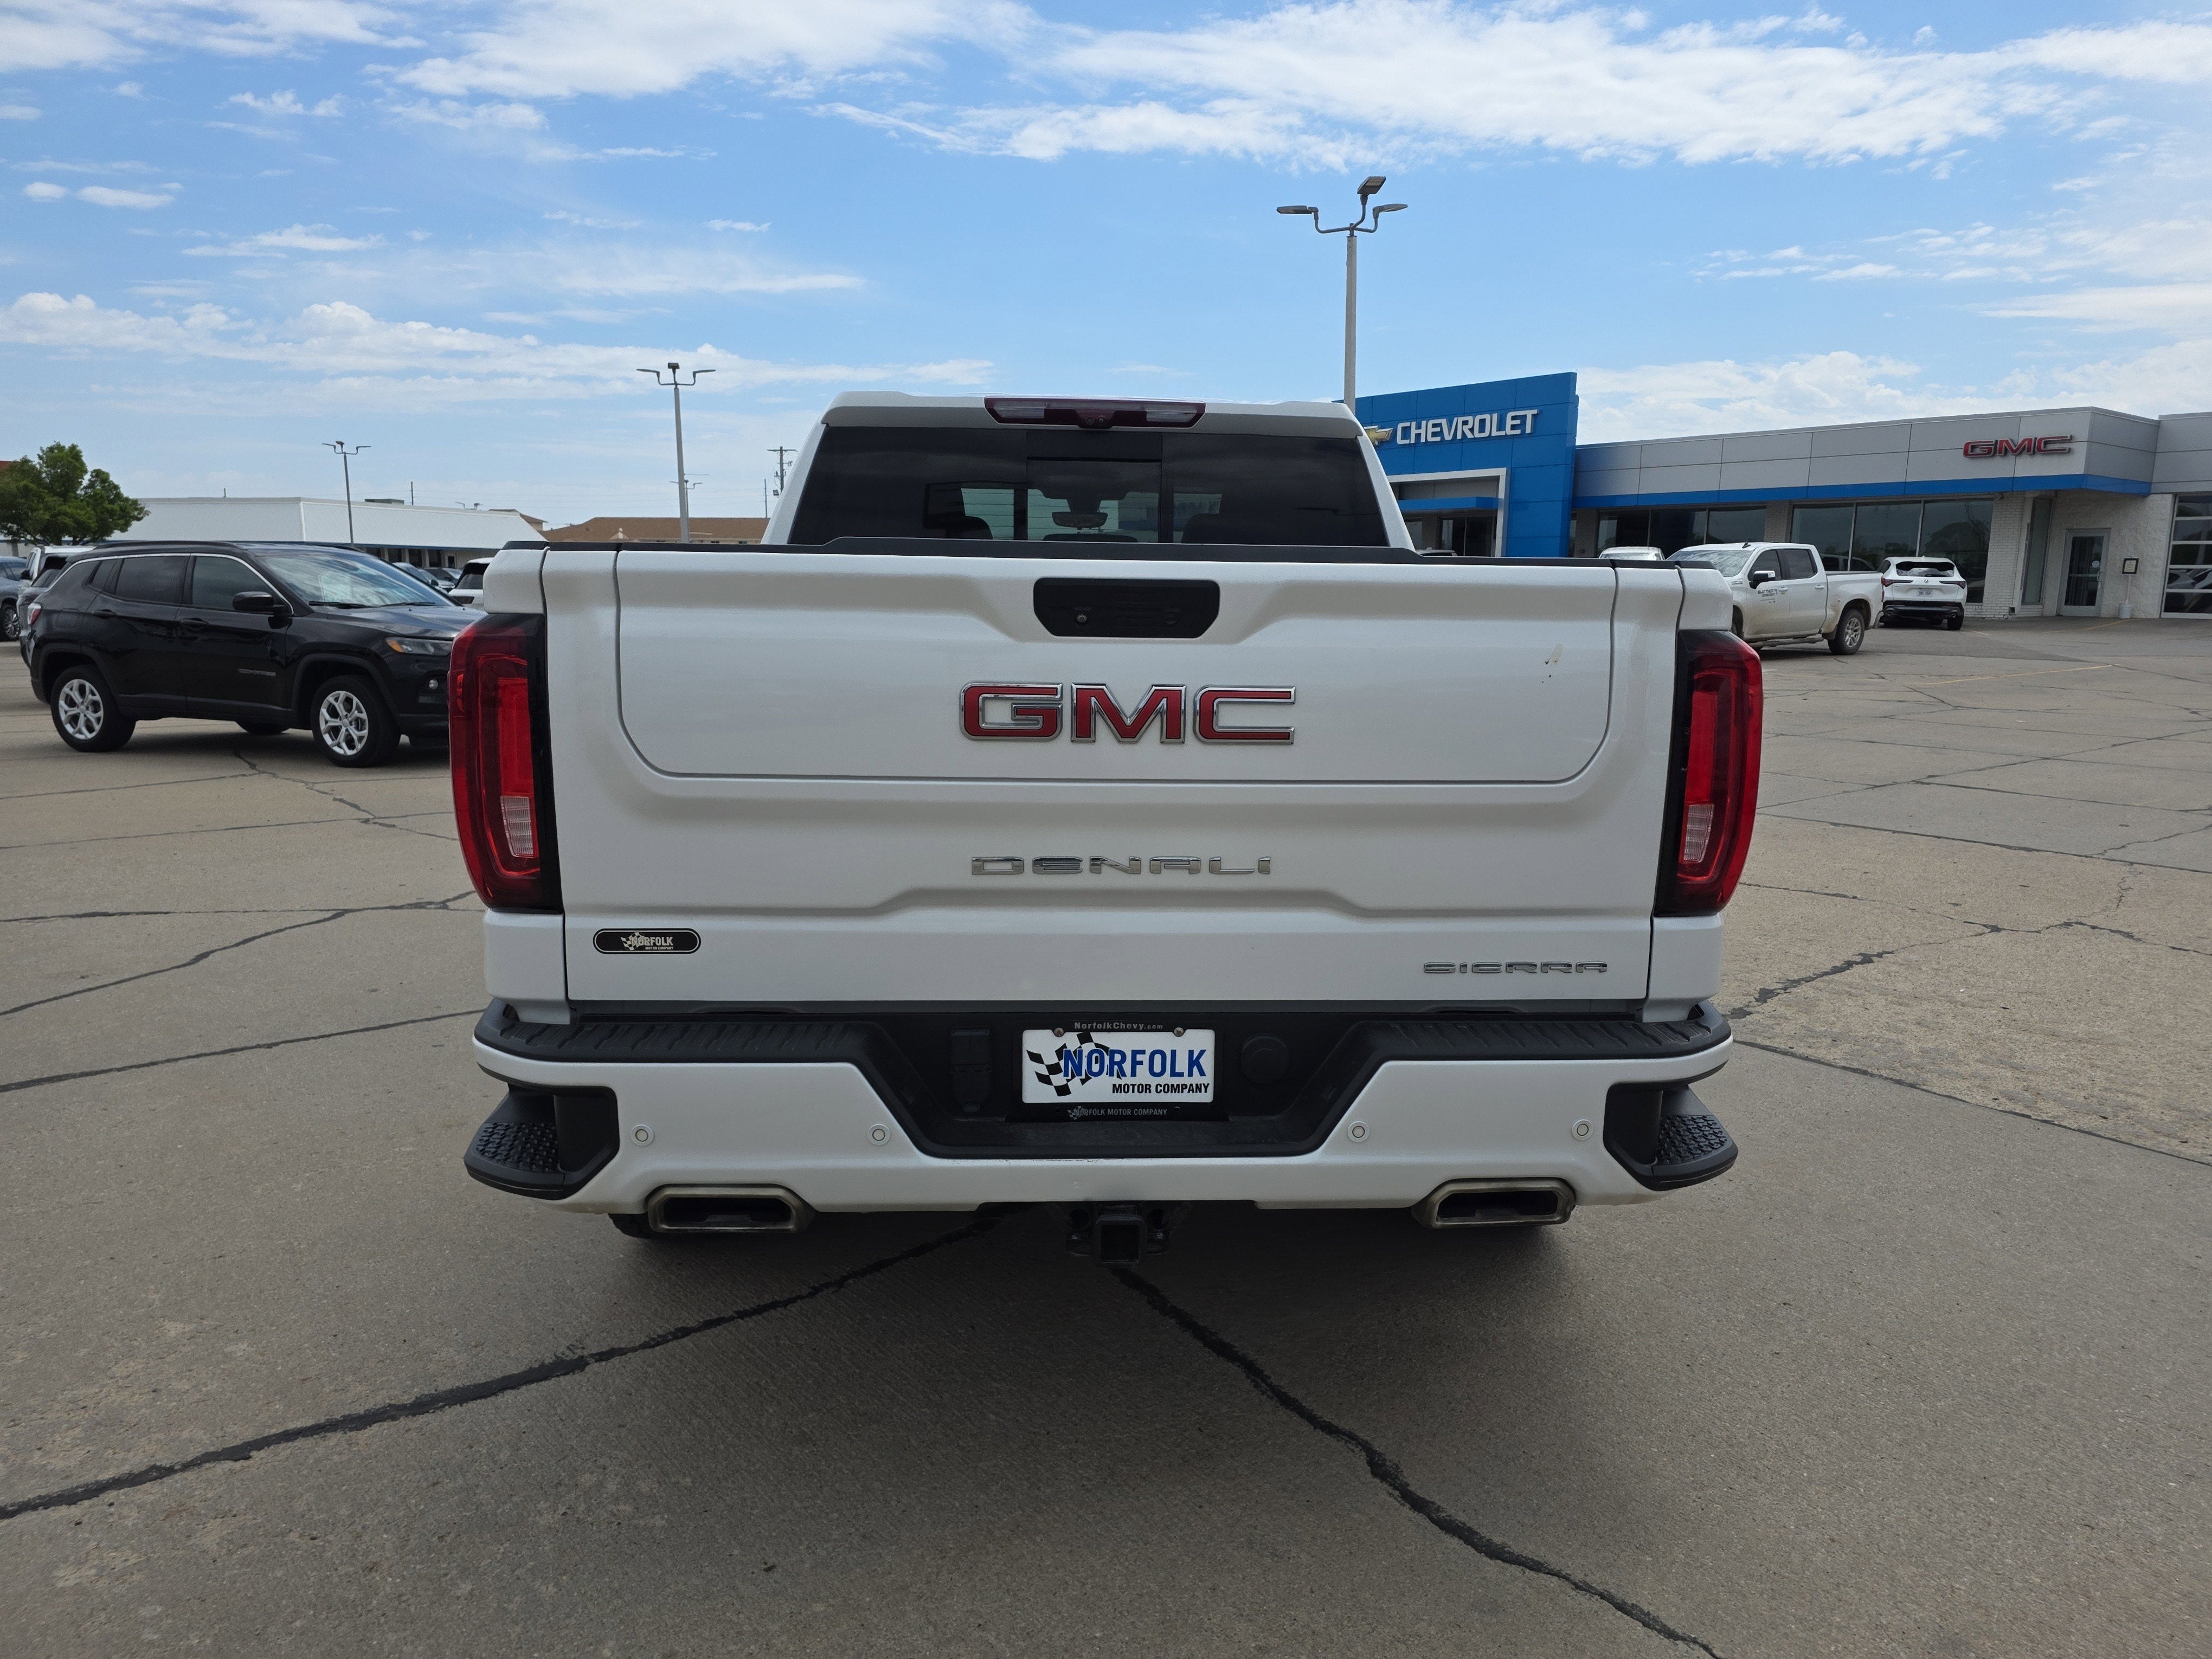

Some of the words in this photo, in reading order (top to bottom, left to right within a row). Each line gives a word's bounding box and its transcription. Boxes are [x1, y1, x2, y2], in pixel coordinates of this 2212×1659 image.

[1397, 409, 1539, 445] CHEVROLET
[1963, 435, 2073, 458] GMC
[960, 681, 1296, 745] GMC
[972, 856, 1271, 875] DENALI
[631, 936, 674, 946] NORFOLK
[1423, 962, 1607, 974] SIERRA
[1074, 1022, 1163, 1030] NorfolkChevy.com
[1063, 1049, 1207, 1078] NORFOLK
[1112, 1083, 1152, 1094] MOTOR
[1155, 1083, 1210, 1094] COMPANY
